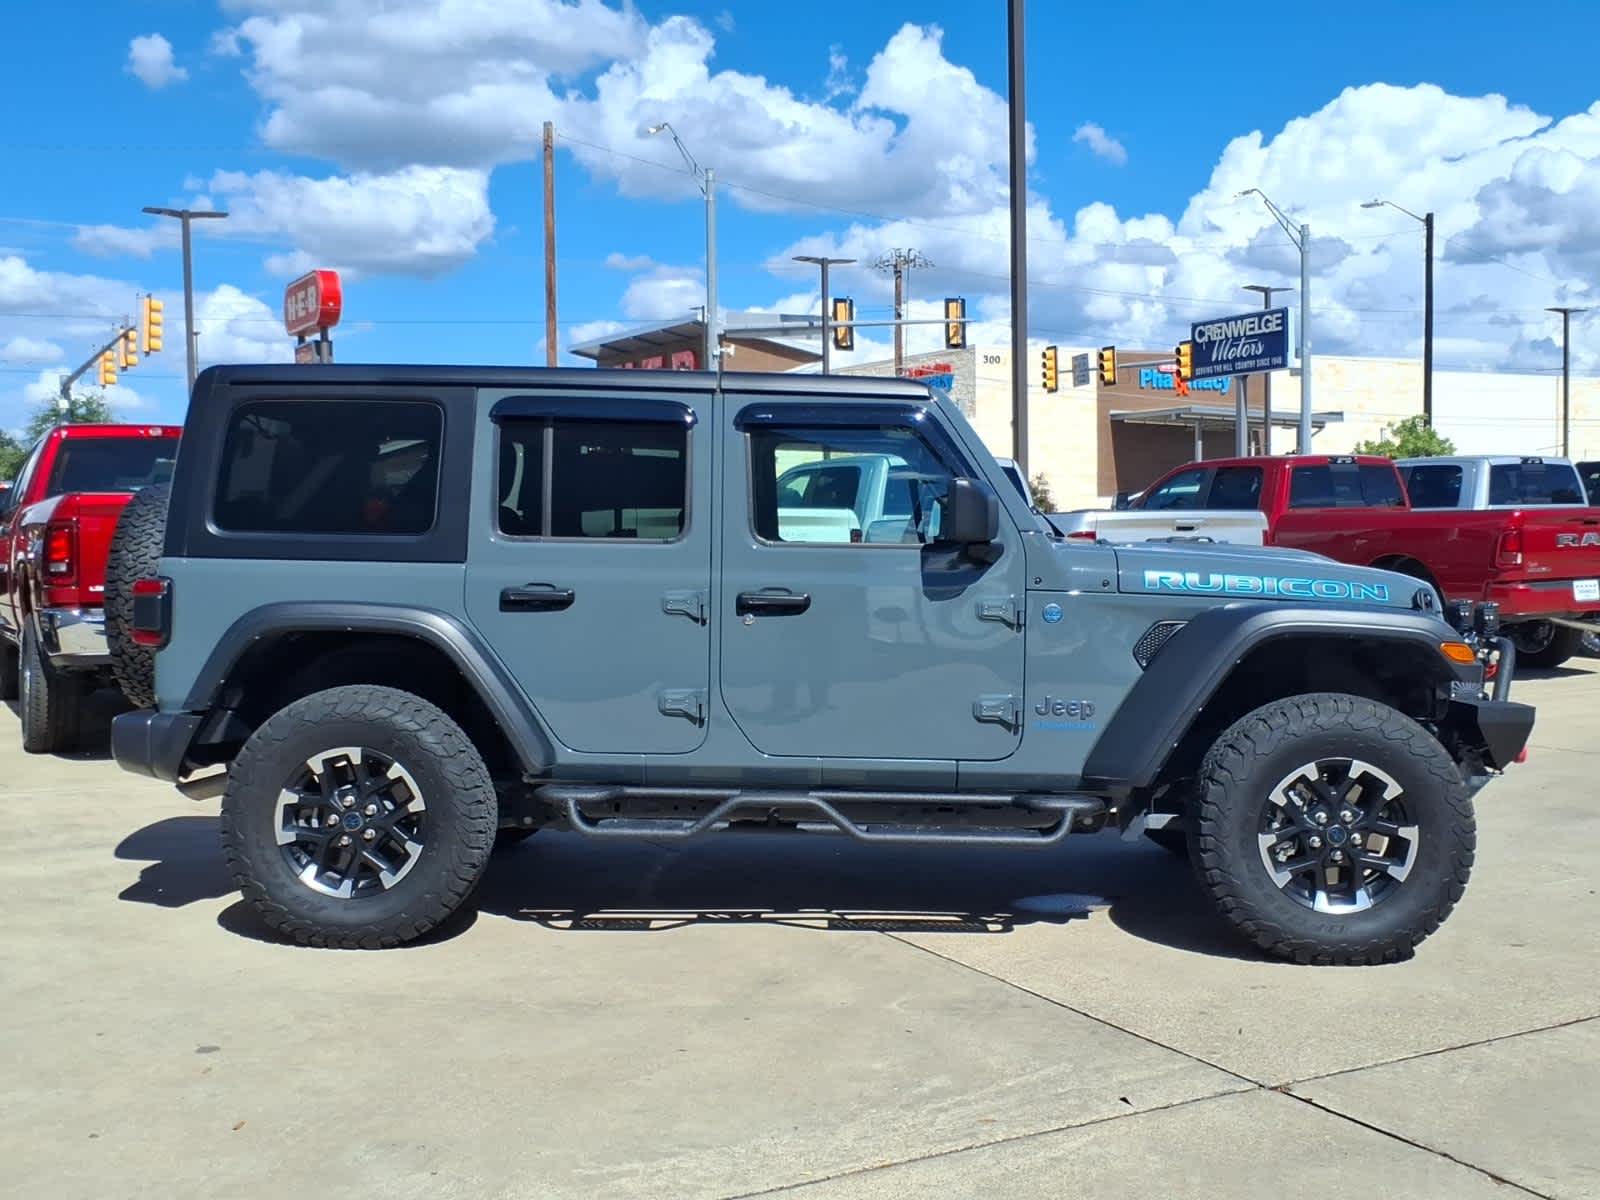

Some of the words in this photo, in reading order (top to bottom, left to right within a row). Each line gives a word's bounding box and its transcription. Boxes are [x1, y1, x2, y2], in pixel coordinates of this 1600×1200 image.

[1194, 313, 1283, 344] CRENWELGE
[983, 355, 1001, 364] 300
[1211, 337, 1265, 362] Motors
[1143, 569, 1389, 601] RUBICON
[1034, 695, 1096, 721] Jeep
